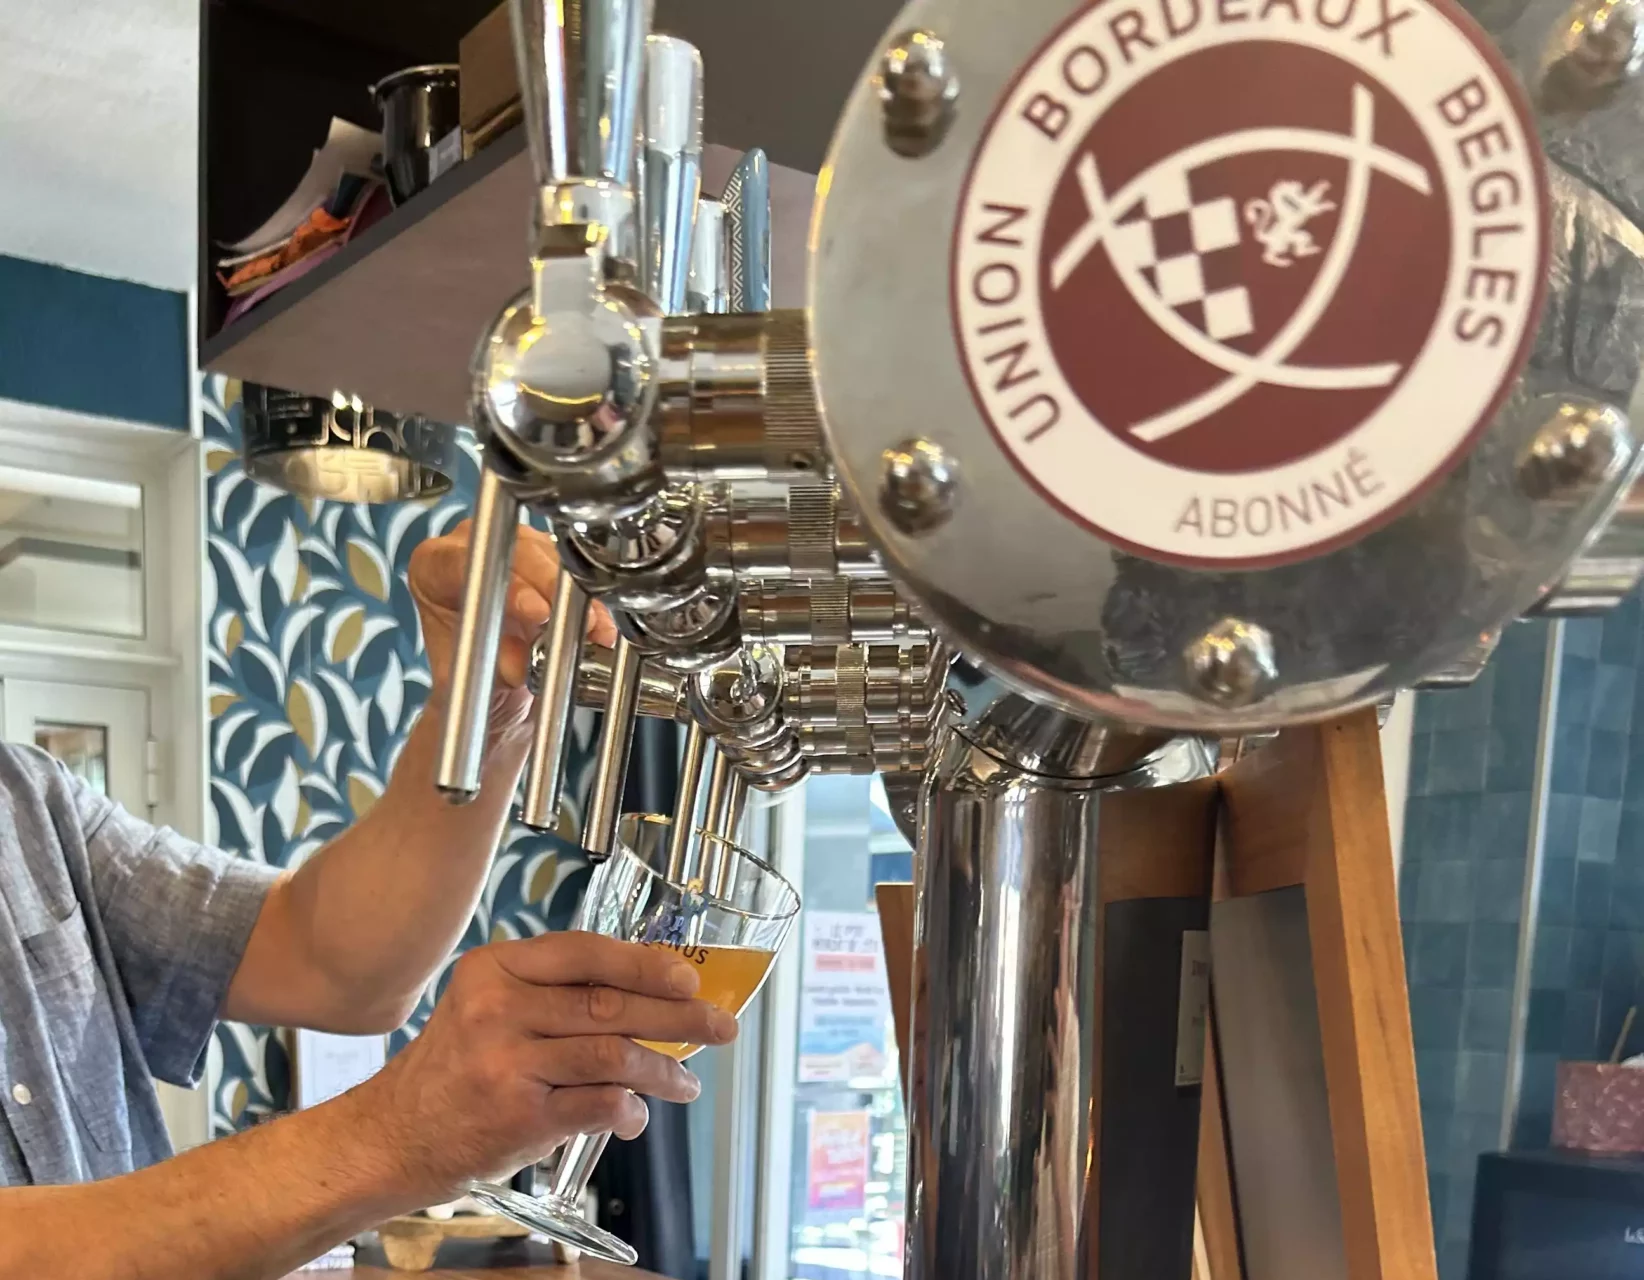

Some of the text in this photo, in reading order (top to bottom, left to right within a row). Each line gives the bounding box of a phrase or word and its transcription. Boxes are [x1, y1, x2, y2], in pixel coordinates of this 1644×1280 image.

[973, 202, 1061, 443] UNION
[1435, 77, 1524, 348] BEGLES
[1173, 446, 1386, 539] ABONNÉ
